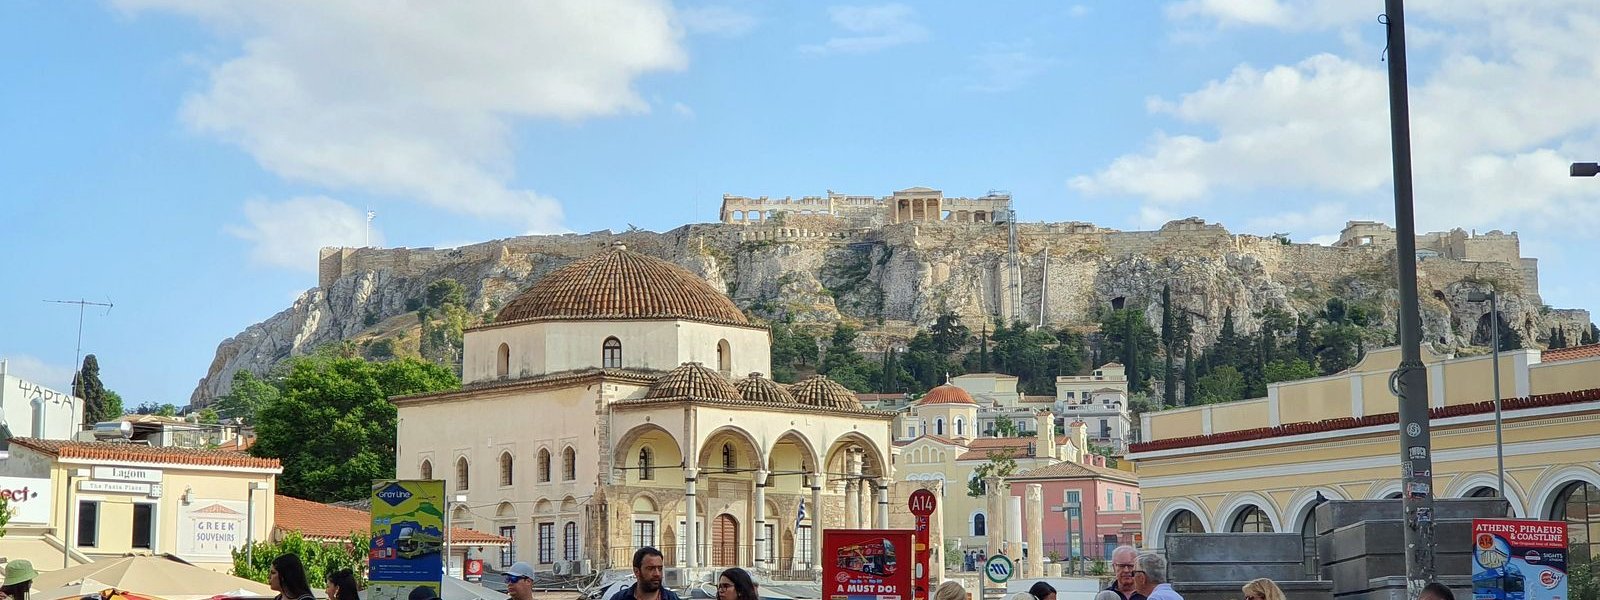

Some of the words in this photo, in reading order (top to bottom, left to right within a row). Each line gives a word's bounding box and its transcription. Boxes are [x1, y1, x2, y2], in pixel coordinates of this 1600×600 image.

[112, 467, 146, 479] Lagom
[911, 495, 933, 511] A14
[198, 521, 235, 531] GREEK
[1476, 523, 1518, 534] ATHENS,
[1520, 525, 1563, 534] PIRAEUS
[196, 532, 235, 542] SOUVENIRS
[1517, 533, 1563, 542] COASTLINE
[837, 584, 844, 592] A
[847, 584, 876, 593] MUST
[877, 585, 896, 593] DO!
